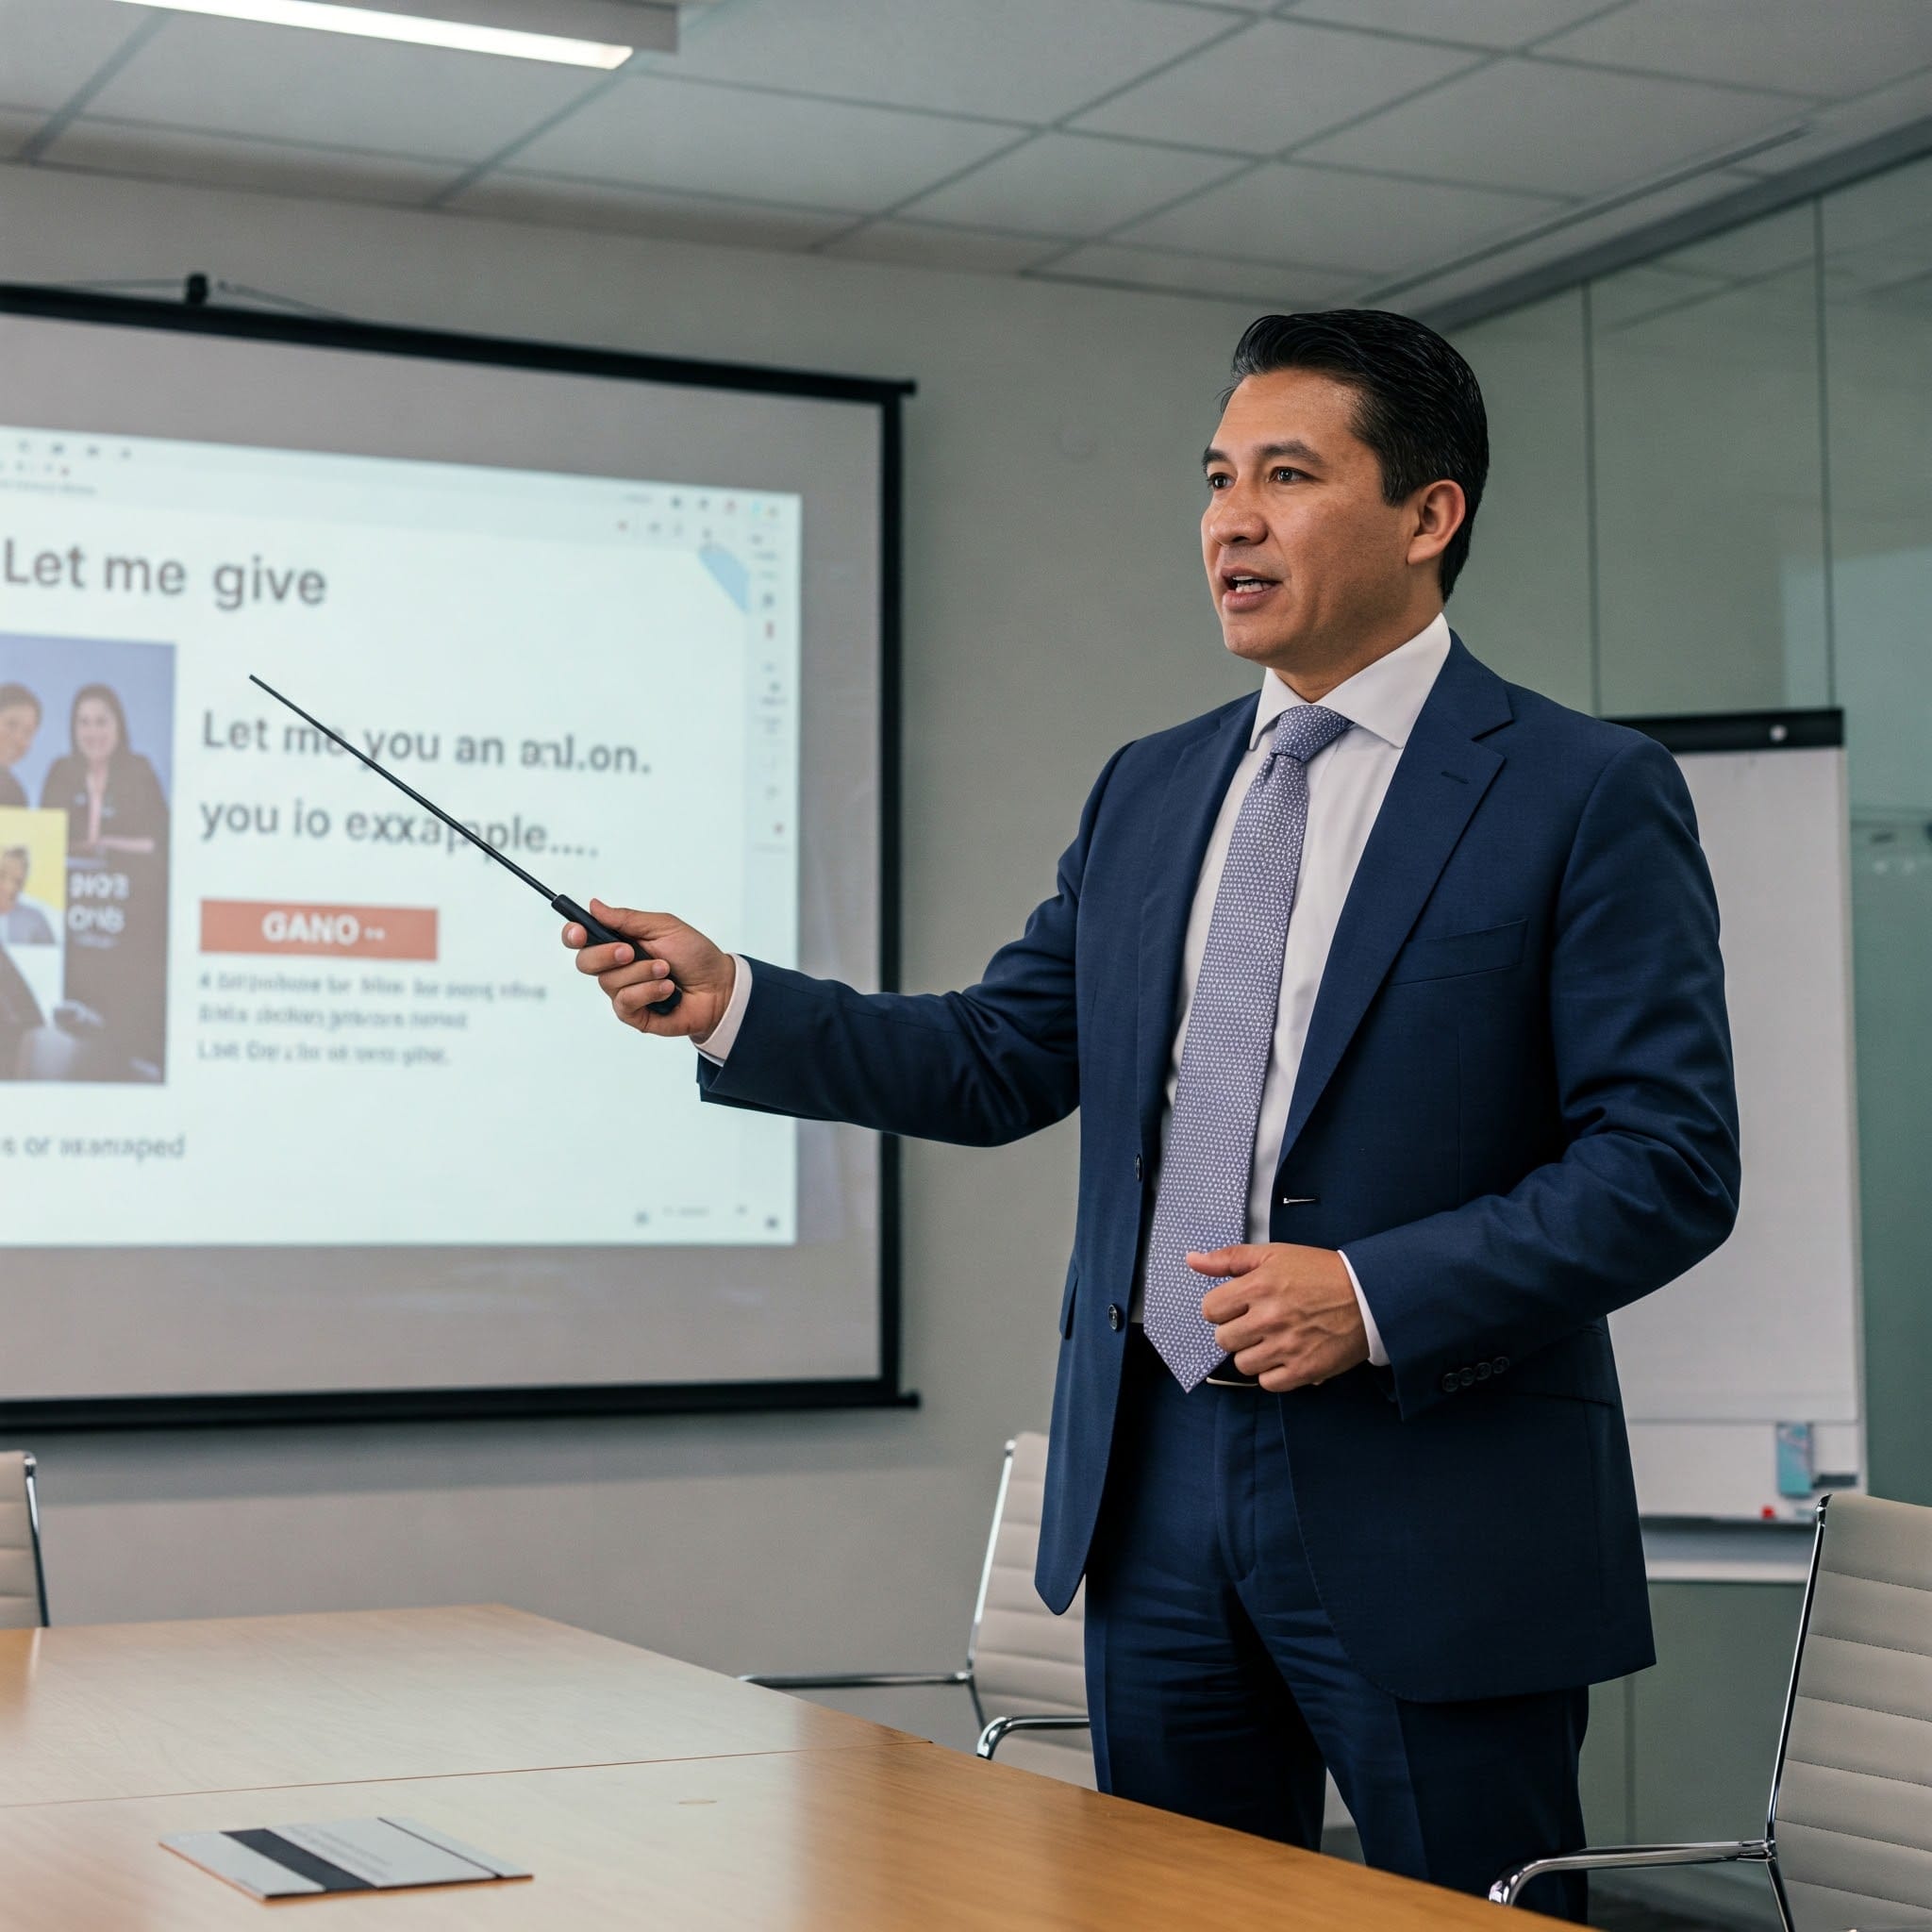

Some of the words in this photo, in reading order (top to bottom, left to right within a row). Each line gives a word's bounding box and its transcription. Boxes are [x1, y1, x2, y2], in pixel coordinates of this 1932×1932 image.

[3, 537, 87, 589] Let
[104, 554, 186, 596] me
[212, 556, 327, 611] give
[203, 708, 268, 751] Let
[359, 728, 439, 771] you
[455, 735, 505, 766] an
[200, 802, 277, 841] you
[262, 910, 359, 945] GANO
